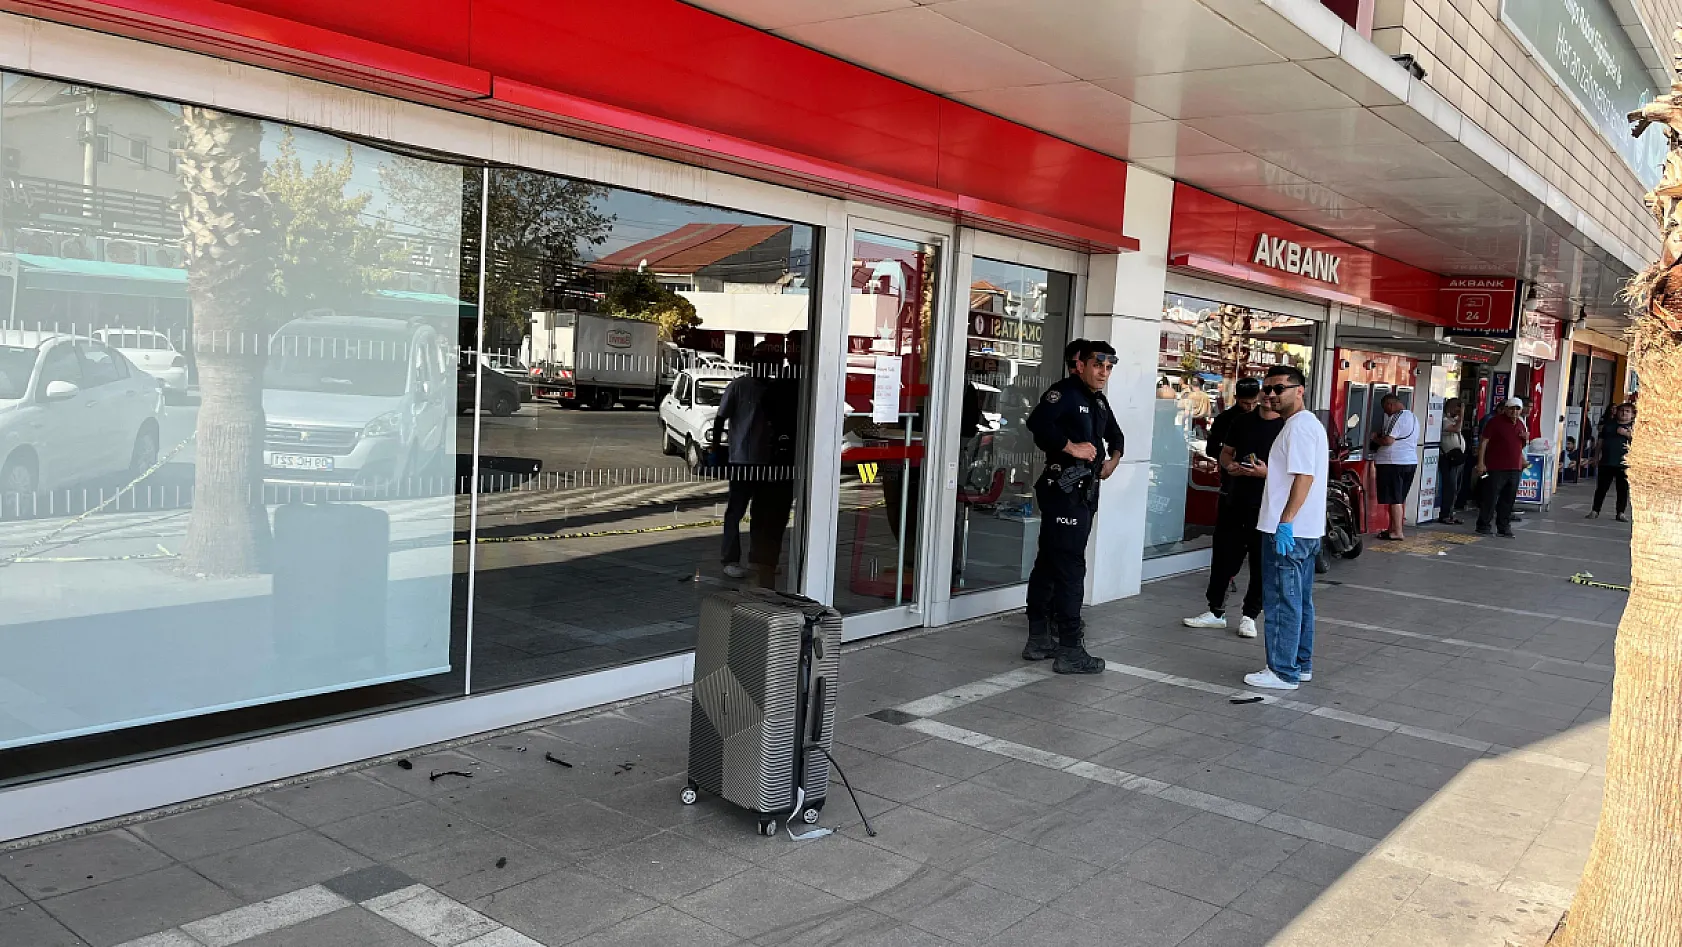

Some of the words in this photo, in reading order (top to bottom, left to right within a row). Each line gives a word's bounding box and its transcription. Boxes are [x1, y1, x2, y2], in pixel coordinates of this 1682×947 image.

[1555, 21, 1571, 69] Her
[1569, 51, 1581, 83] an
[1253, 232, 1341, 284] AKBANK
[1449, 280, 1505, 288] AKBANK
[1465, 311, 1479, 320] 24
